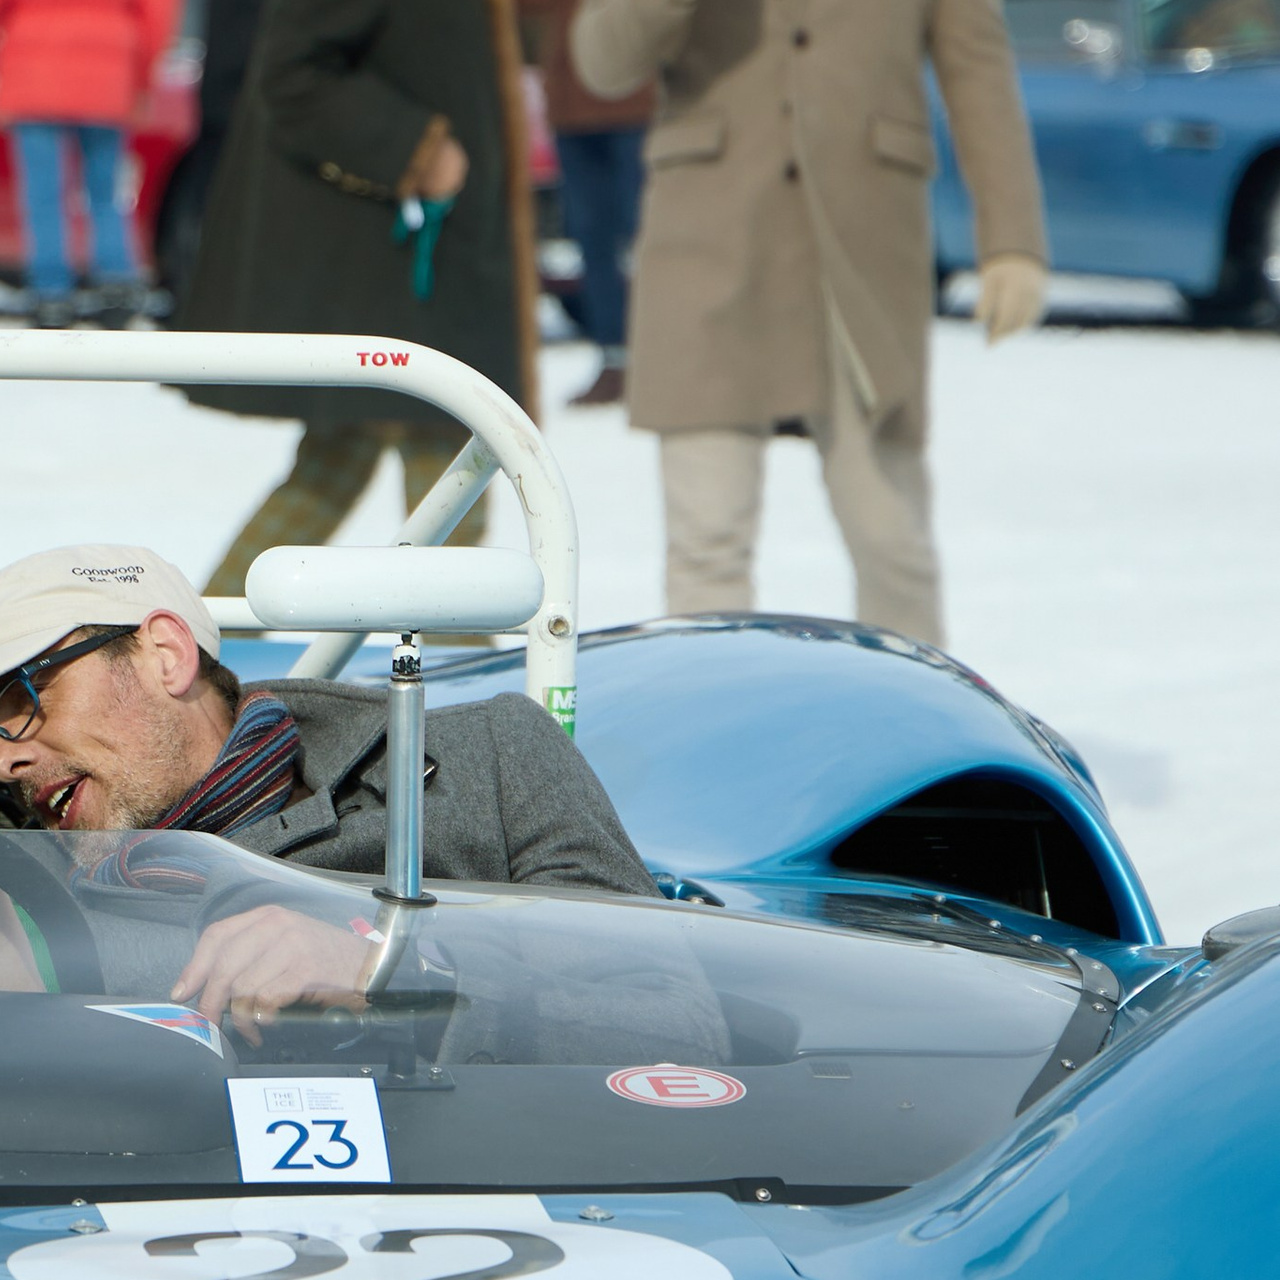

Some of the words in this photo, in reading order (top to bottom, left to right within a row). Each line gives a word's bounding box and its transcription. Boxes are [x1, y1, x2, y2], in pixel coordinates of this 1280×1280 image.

[356, 352, 410, 367] TOW
[72, 565, 145, 576] GOODWOOD
[646, 1076, 711, 1098] E
[266, 1119, 359, 1170] 23
